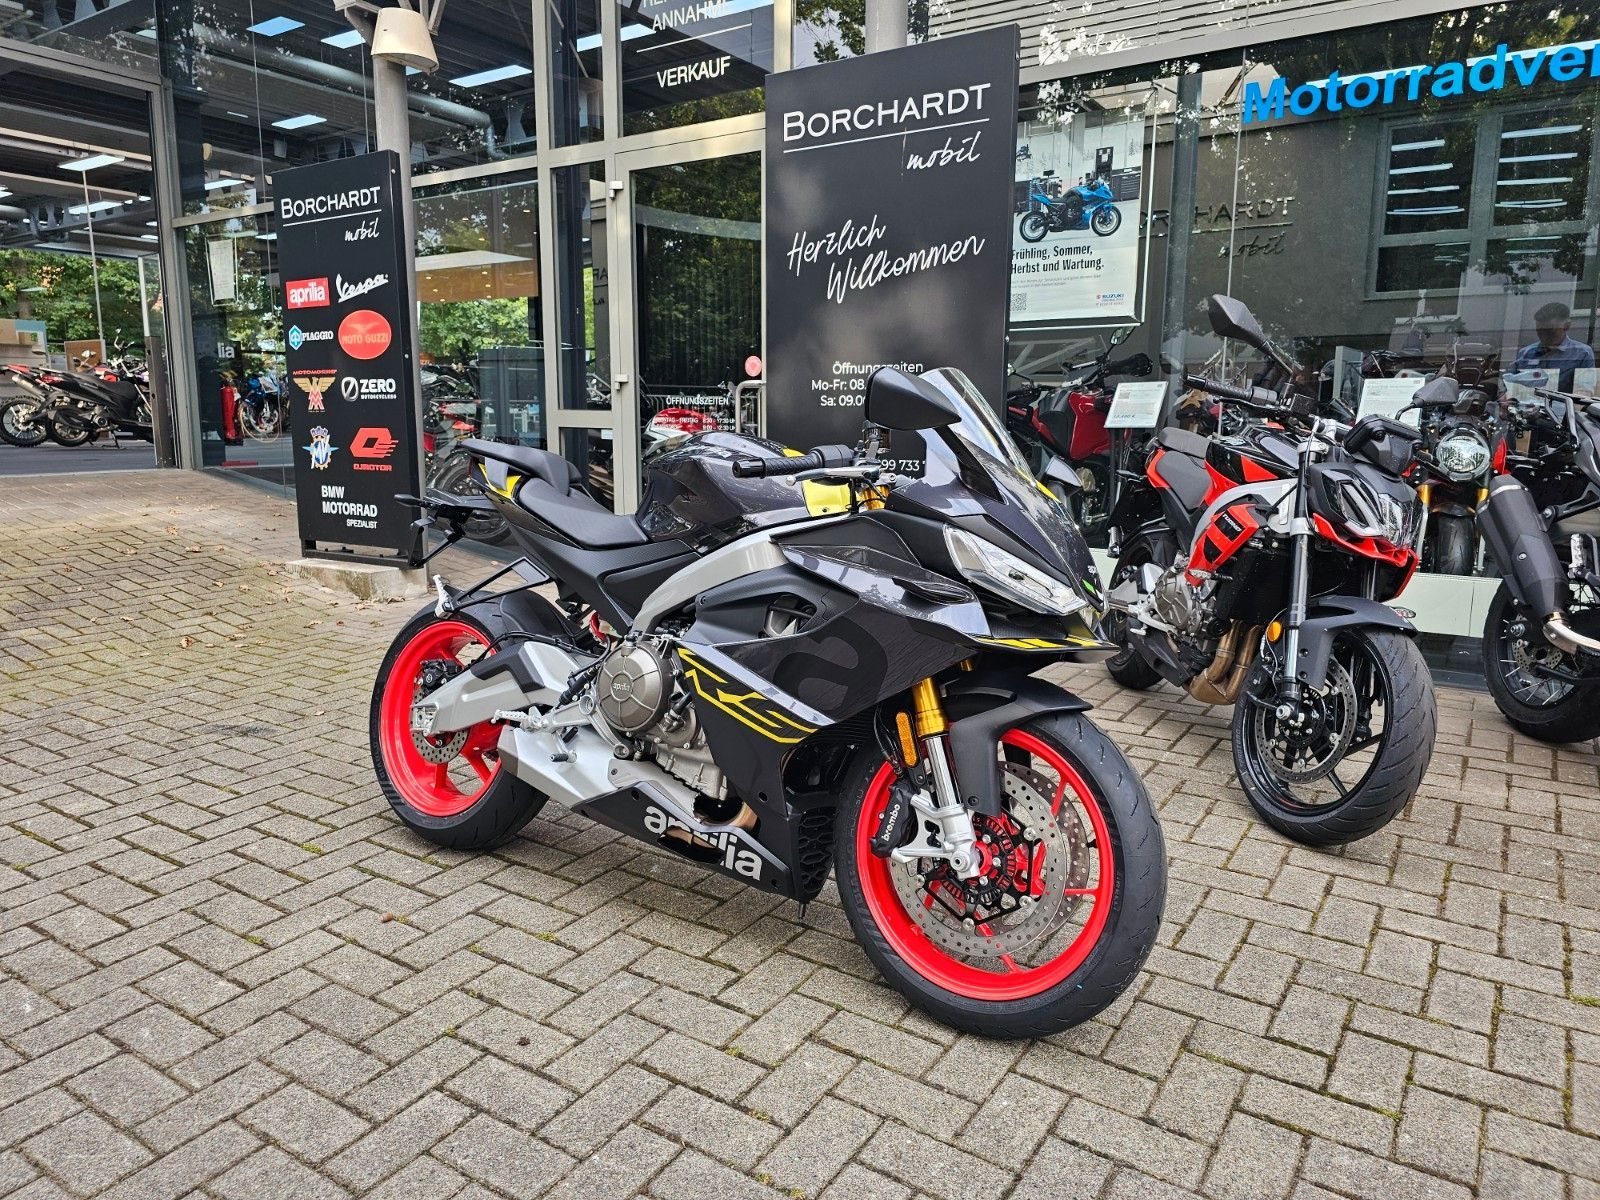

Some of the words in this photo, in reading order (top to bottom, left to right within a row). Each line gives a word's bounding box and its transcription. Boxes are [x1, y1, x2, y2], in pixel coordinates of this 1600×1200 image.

[656, 55, 731, 88] VERKAUF
[783, 83, 991, 142] BORCHARDT
[906, 131, 982, 170] mobil
[281, 186, 380, 219] BORCHARDT
[344, 217, 379, 241] mobil
[787, 214, 887, 277] Herzlich
[1053, 245, 1093, 256] Sommer,
[827, 235, 986, 304] Willkommen
[1042, 260, 1060, 272] und
[1062, 258, 1104, 271] Wartung.
[290, 281, 326, 306] aprilia
[336, 273, 388, 303] Vespa
[302, 331, 334, 341] PIAGGIO
[342, 335, 363, 345] MOTO
[365, 333, 389, 344] GUZZI
[832, 361, 923, 374] Öffnuneiten
[360, 379, 396, 393] ZERO
[811, 379, 847, 391] Mo-Fr:
[849, 379, 867, 391] 08.
[820, 395, 837, 406] Sa:
[898, 459, 920, 471] 733
[321, 485, 345, 498] BMW
[322, 501, 378, 517] MOTORRAD
[346, 518, 378, 529] SPEZIALIST
[881, 804, 901, 842] brembo
